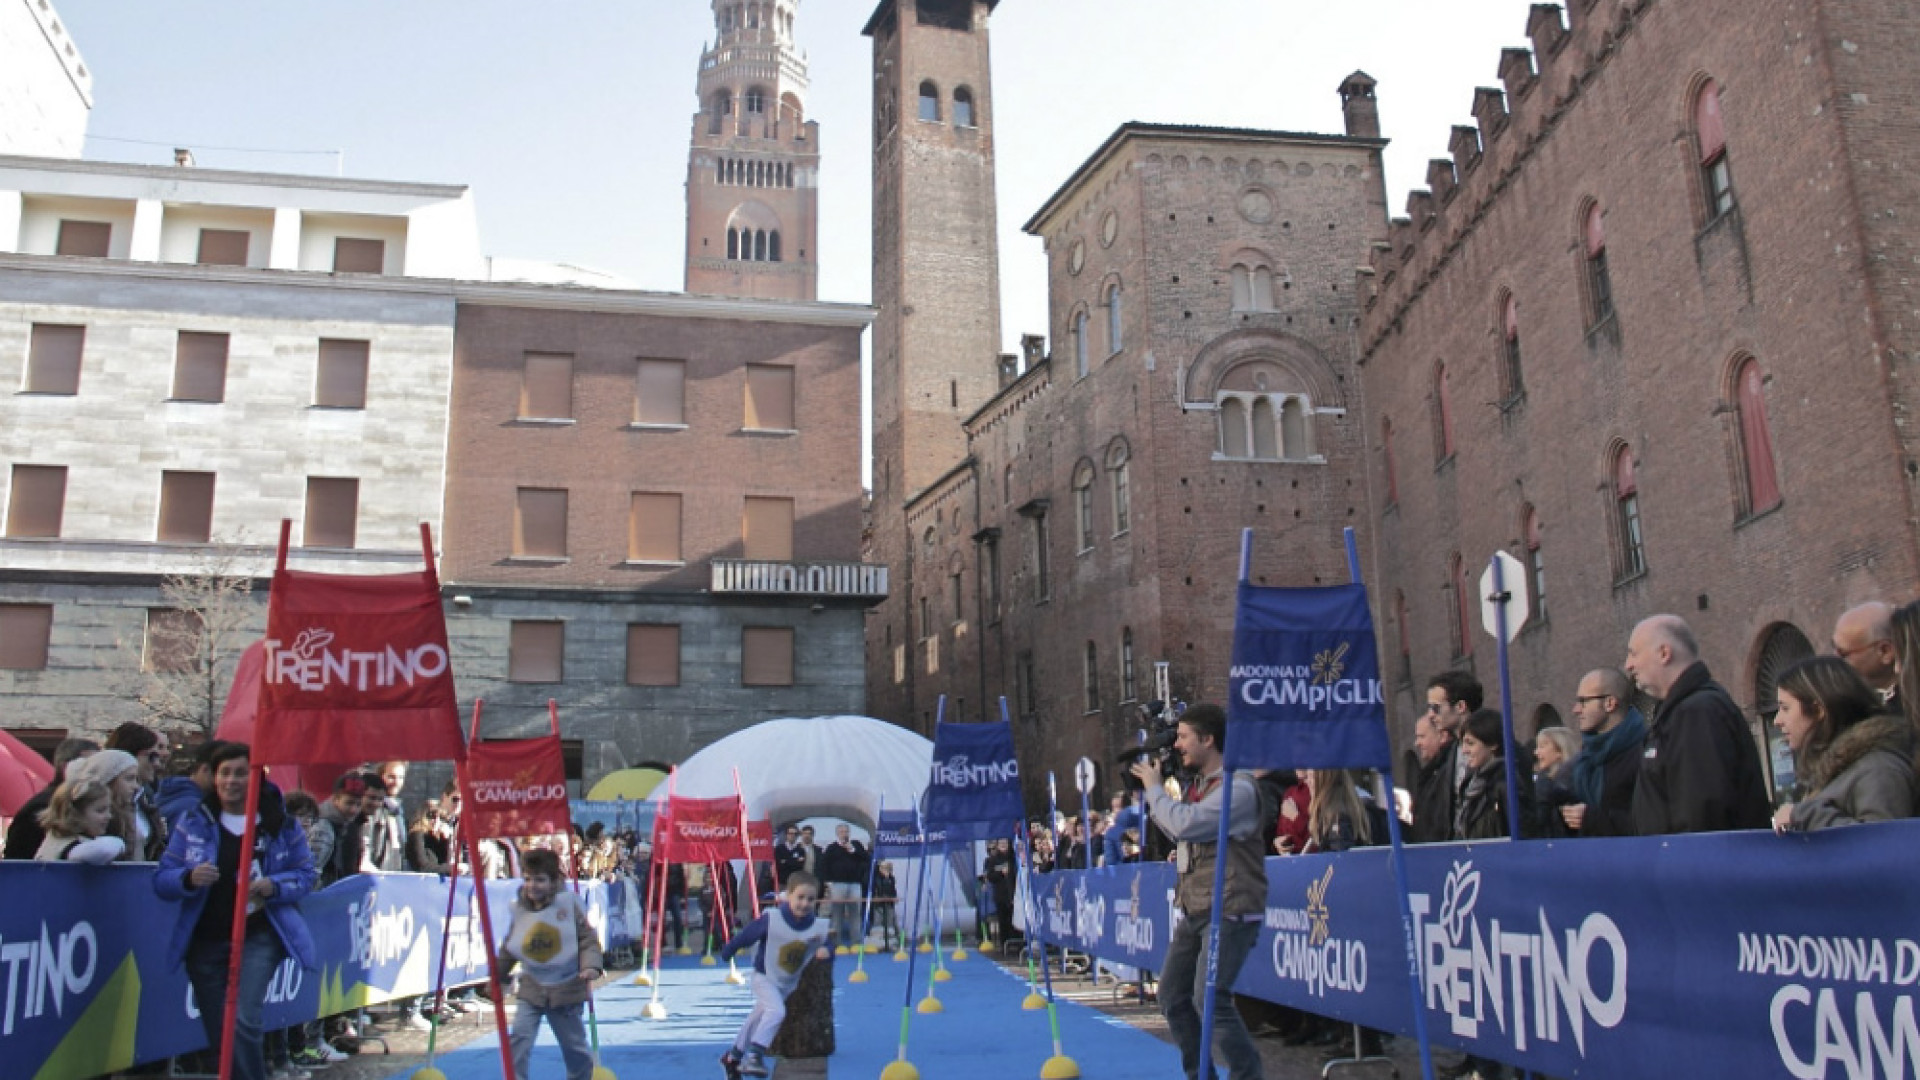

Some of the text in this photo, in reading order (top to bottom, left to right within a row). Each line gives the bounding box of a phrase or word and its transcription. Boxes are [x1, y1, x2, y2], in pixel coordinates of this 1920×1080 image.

[264, 639, 448, 691] TRENTINO
[1296, 665, 1310, 677] DI
[932, 760, 1018, 787] TRENTINO
[0, 919, 97, 1035] TINO
[1273, 931, 1367, 998] CAMPIGLIO
[1408, 893, 1627, 1059] TRENTINO
[1737, 932, 1920, 986] MADONNA D
